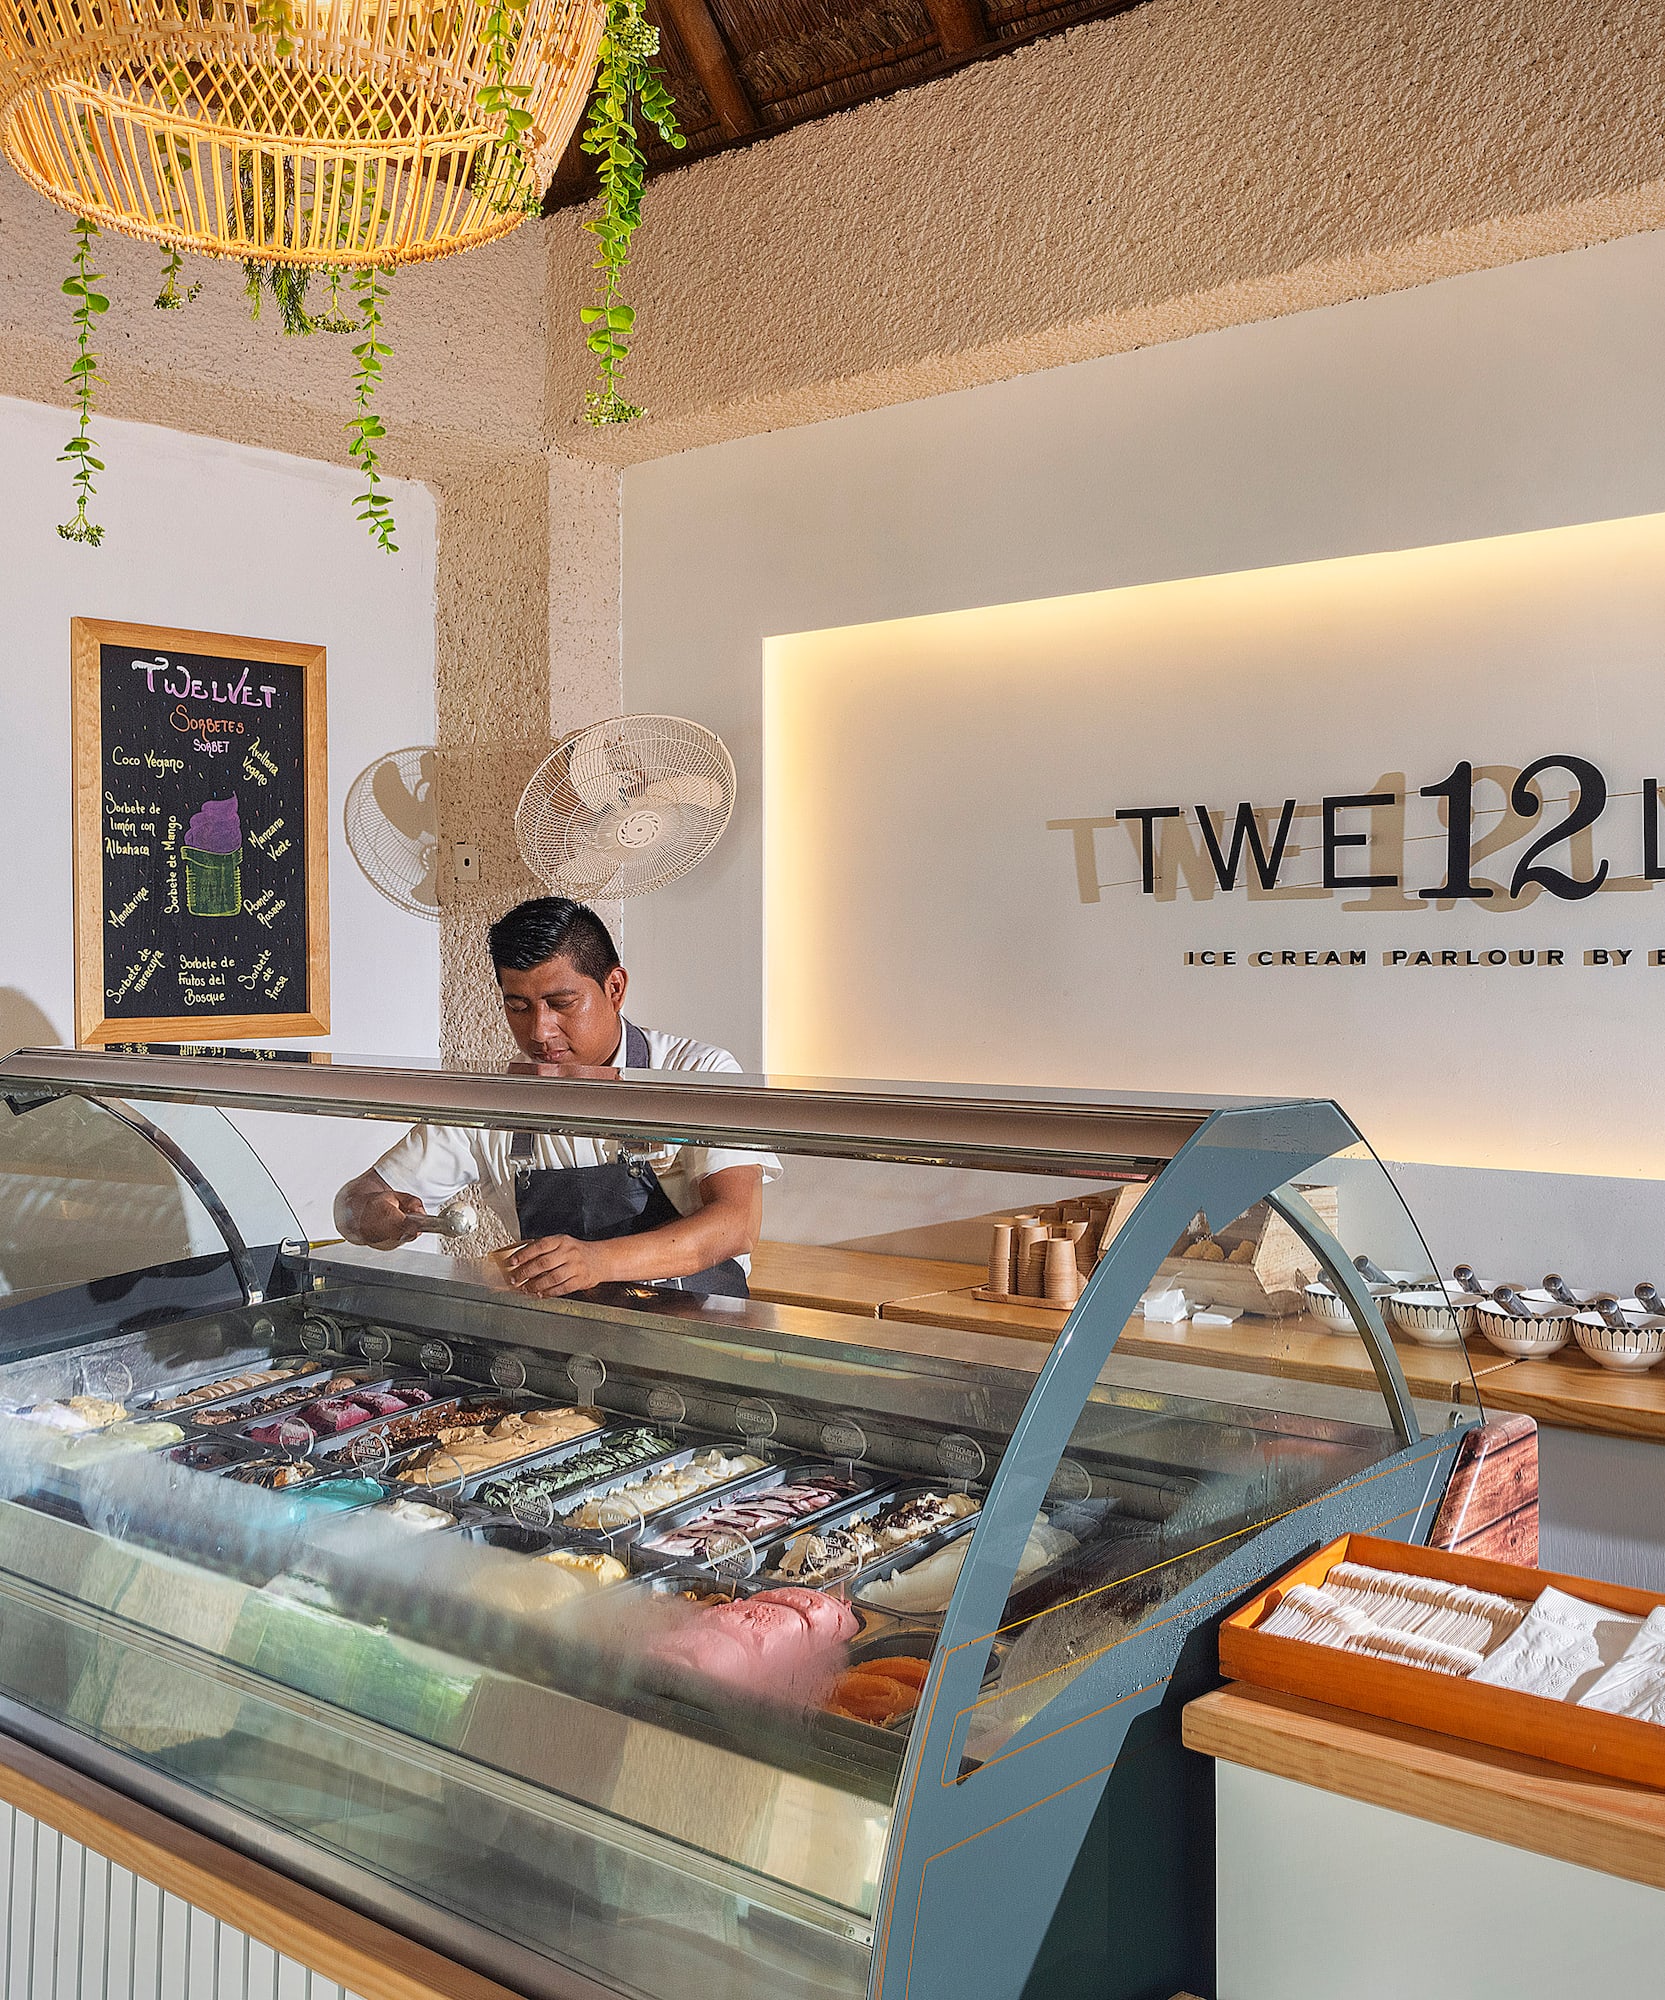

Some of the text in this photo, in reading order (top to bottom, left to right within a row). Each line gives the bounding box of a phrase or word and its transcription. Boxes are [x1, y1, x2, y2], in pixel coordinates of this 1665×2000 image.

[131, 657, 276, 709] TWELVET
[169, 704, 245, 742] SORBETES
[193, 738, 230, 758] SORBET
[248, 736, 280, 777] Avellana
[112, 745, 185, 778] Coco Vegano
[242, 756, 268, 787] Vegano
[104, 790, 161, 815] Sorbete de
[140, 822, 157, 838] con
[248, 817, 285, 850] Manzana
[104, 836, 151, 860] Albahaca
[267, 838, 293, 861] Verde
[161, 815, 182, 914] Sorbete de Mango
[107, 886, 150, 929] Mandarina
[243, 889, 275, 916] Pomelo
[257, 899, 287, 930] Rosado
[179, 954, 236, 970] Sorbete de
[237, 949, 272, 990] Sorbete
[1188, 950, 1236, 965] ICE
[1257, 950, 1366, 966] CREAM
[1392, 949, 1564, 966] PARLOUR
[1593, 949, 1632, 965] BY
[106, 948, 152, 1004] Sorbete de
[178, 972, 225, 986] Frutos del
[262, 966, 275, 982] de
[184, 989, 226, 1006] Bosque
[264, 975, 289, 1001] fresa
[607, 1512, 632, 1526] MANGO
